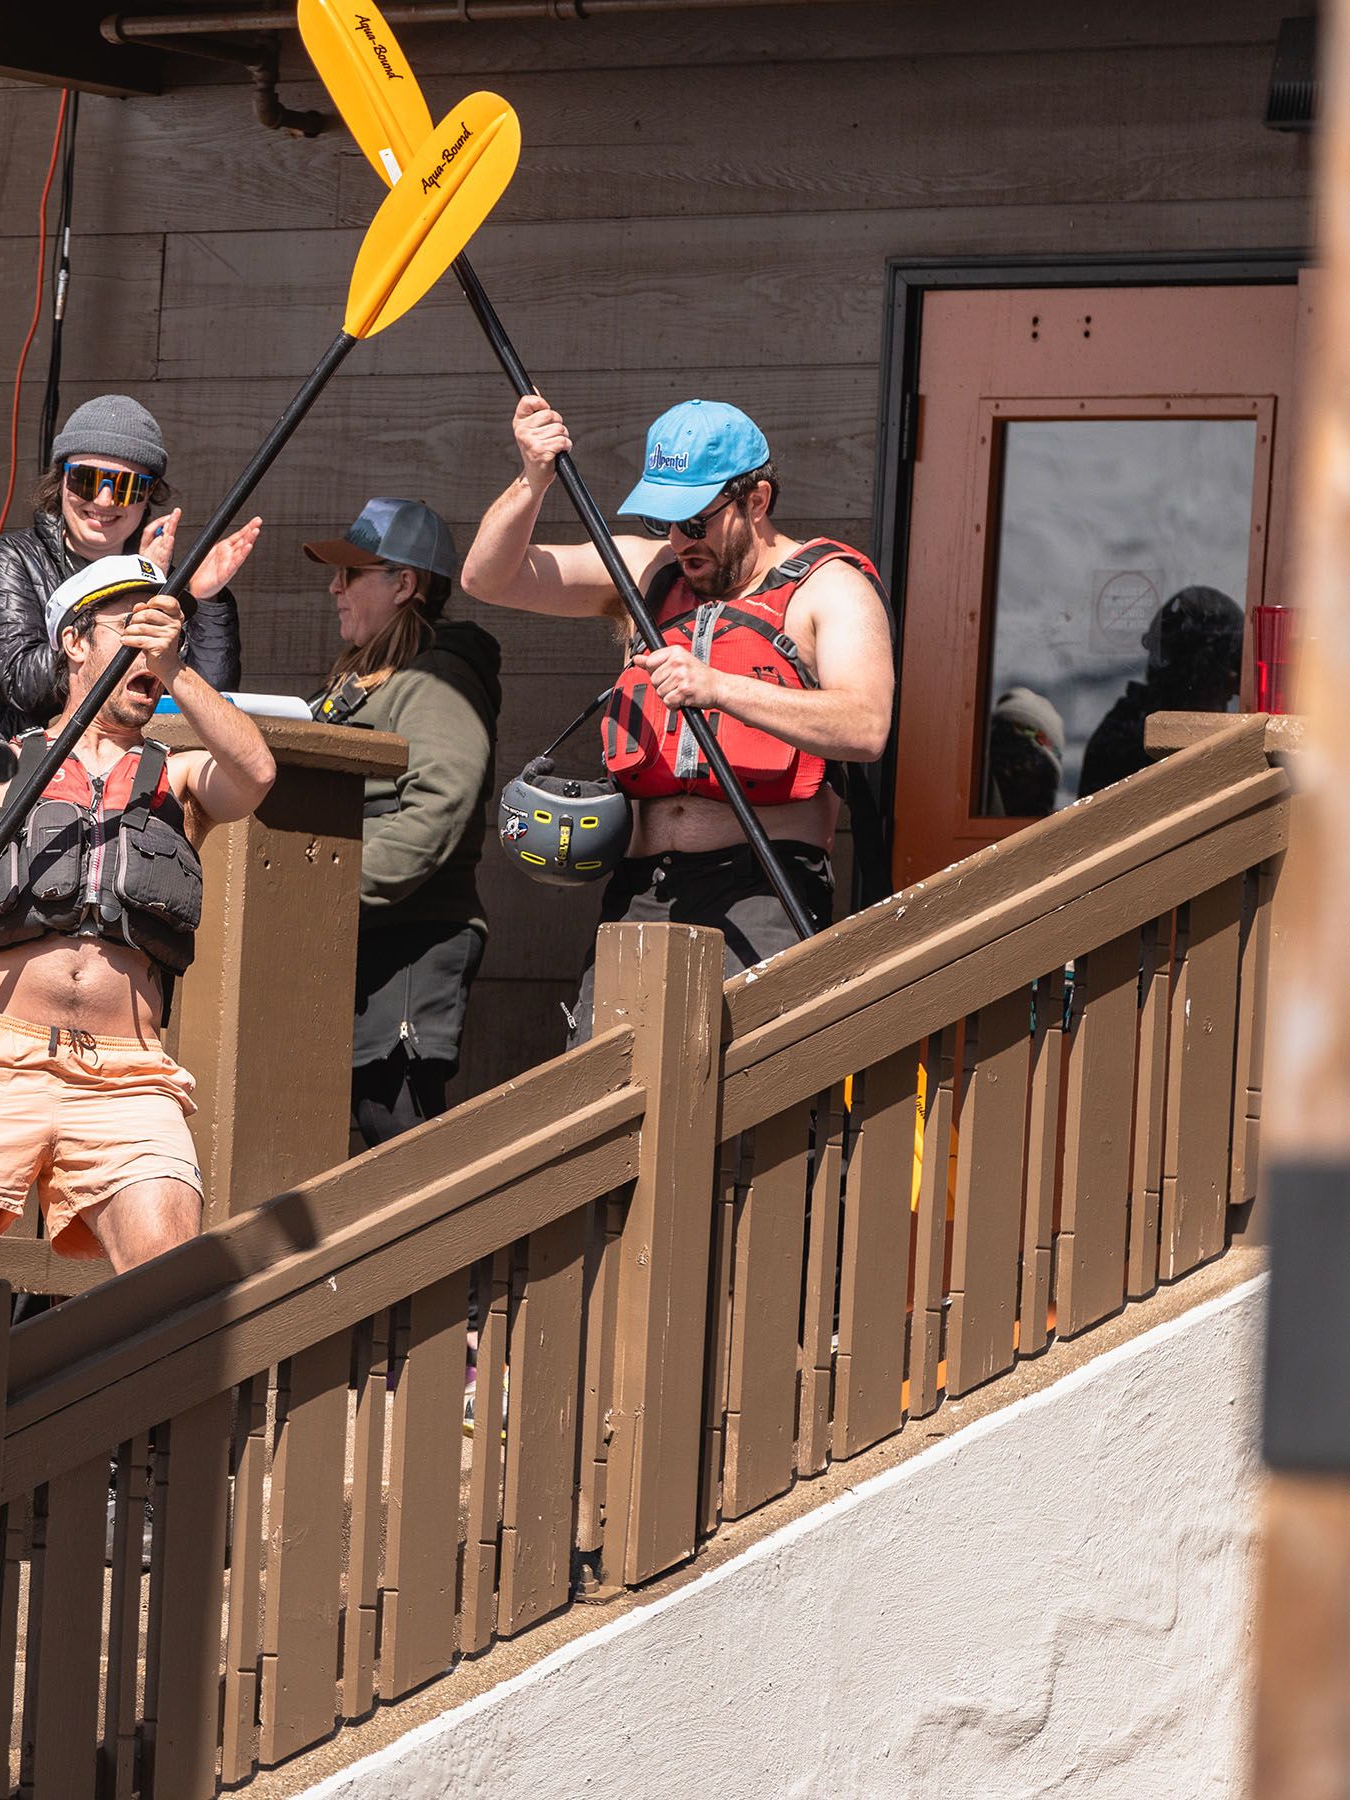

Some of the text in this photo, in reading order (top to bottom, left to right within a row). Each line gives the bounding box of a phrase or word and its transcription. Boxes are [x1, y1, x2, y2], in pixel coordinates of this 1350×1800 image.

[355, 14, 404, 79] Aqua-Bound
[421, 121, 472, 195] Aqua-Bound
[649, 442, 689, 473] Alpental
